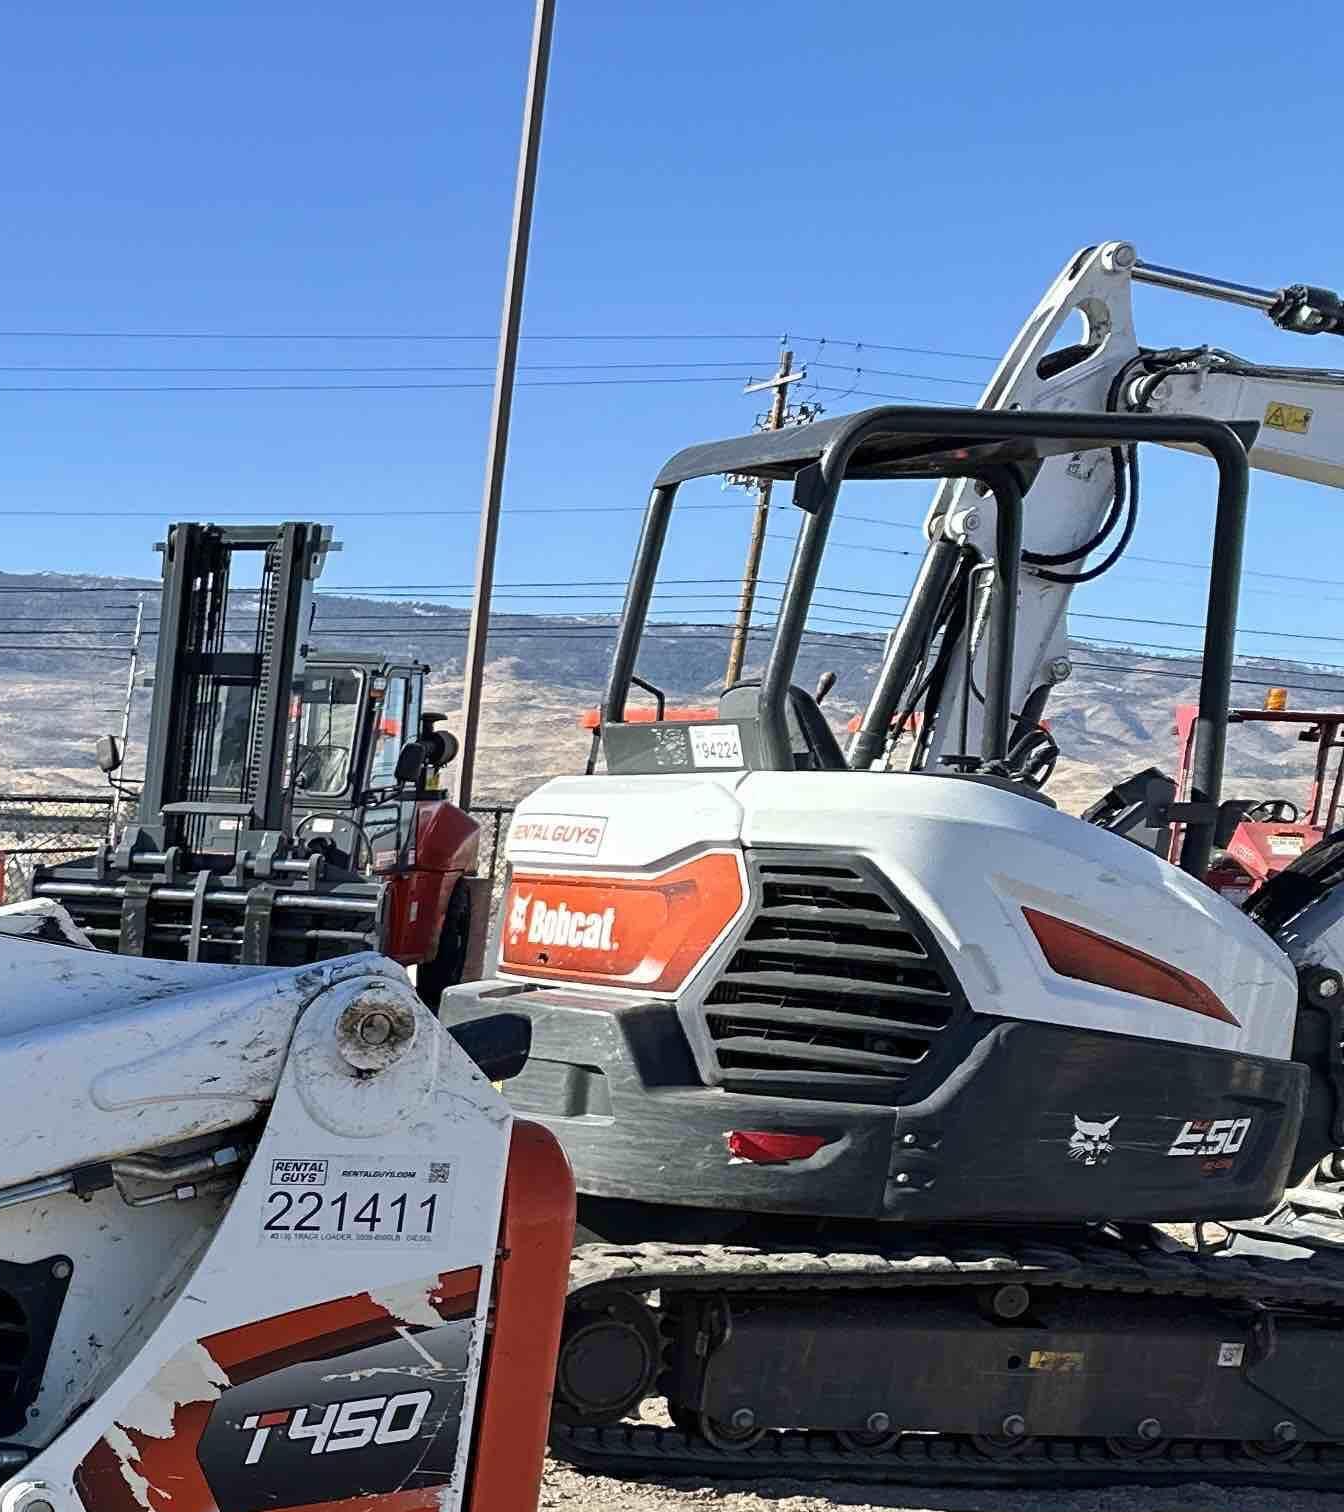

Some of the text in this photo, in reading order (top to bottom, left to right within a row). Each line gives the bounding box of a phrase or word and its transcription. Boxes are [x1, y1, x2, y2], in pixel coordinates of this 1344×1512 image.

[551, 825, 601, 845] GUYS
[527, 900, 616, 951] Bobcat
[1167, 1117, 1252, 1155] E50
[274, 1162, 325, 1173] RENTAL
[280, 1172, 317, 1183] GUYS
[264, 1190, 437, 1233] 221411
[242, 1390, 432, 1465] T450
